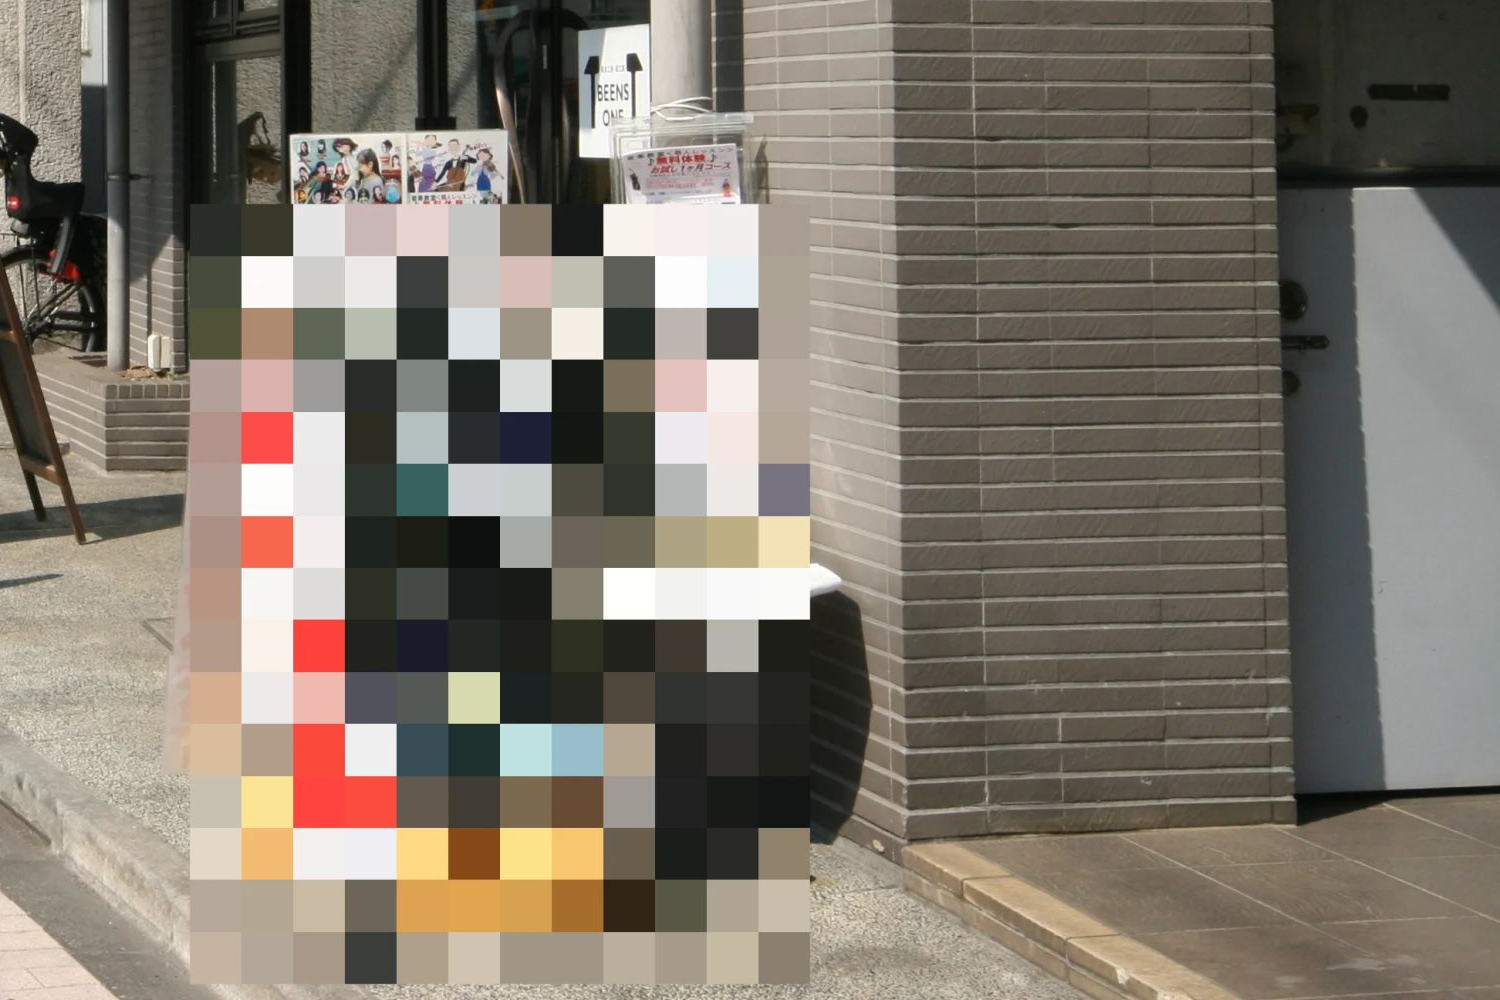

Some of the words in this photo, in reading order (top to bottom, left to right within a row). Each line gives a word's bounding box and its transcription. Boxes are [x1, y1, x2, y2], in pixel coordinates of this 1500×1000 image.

[597, 83, 629, 102] BEENS
[656, 153, 706, 166] 無料体験
